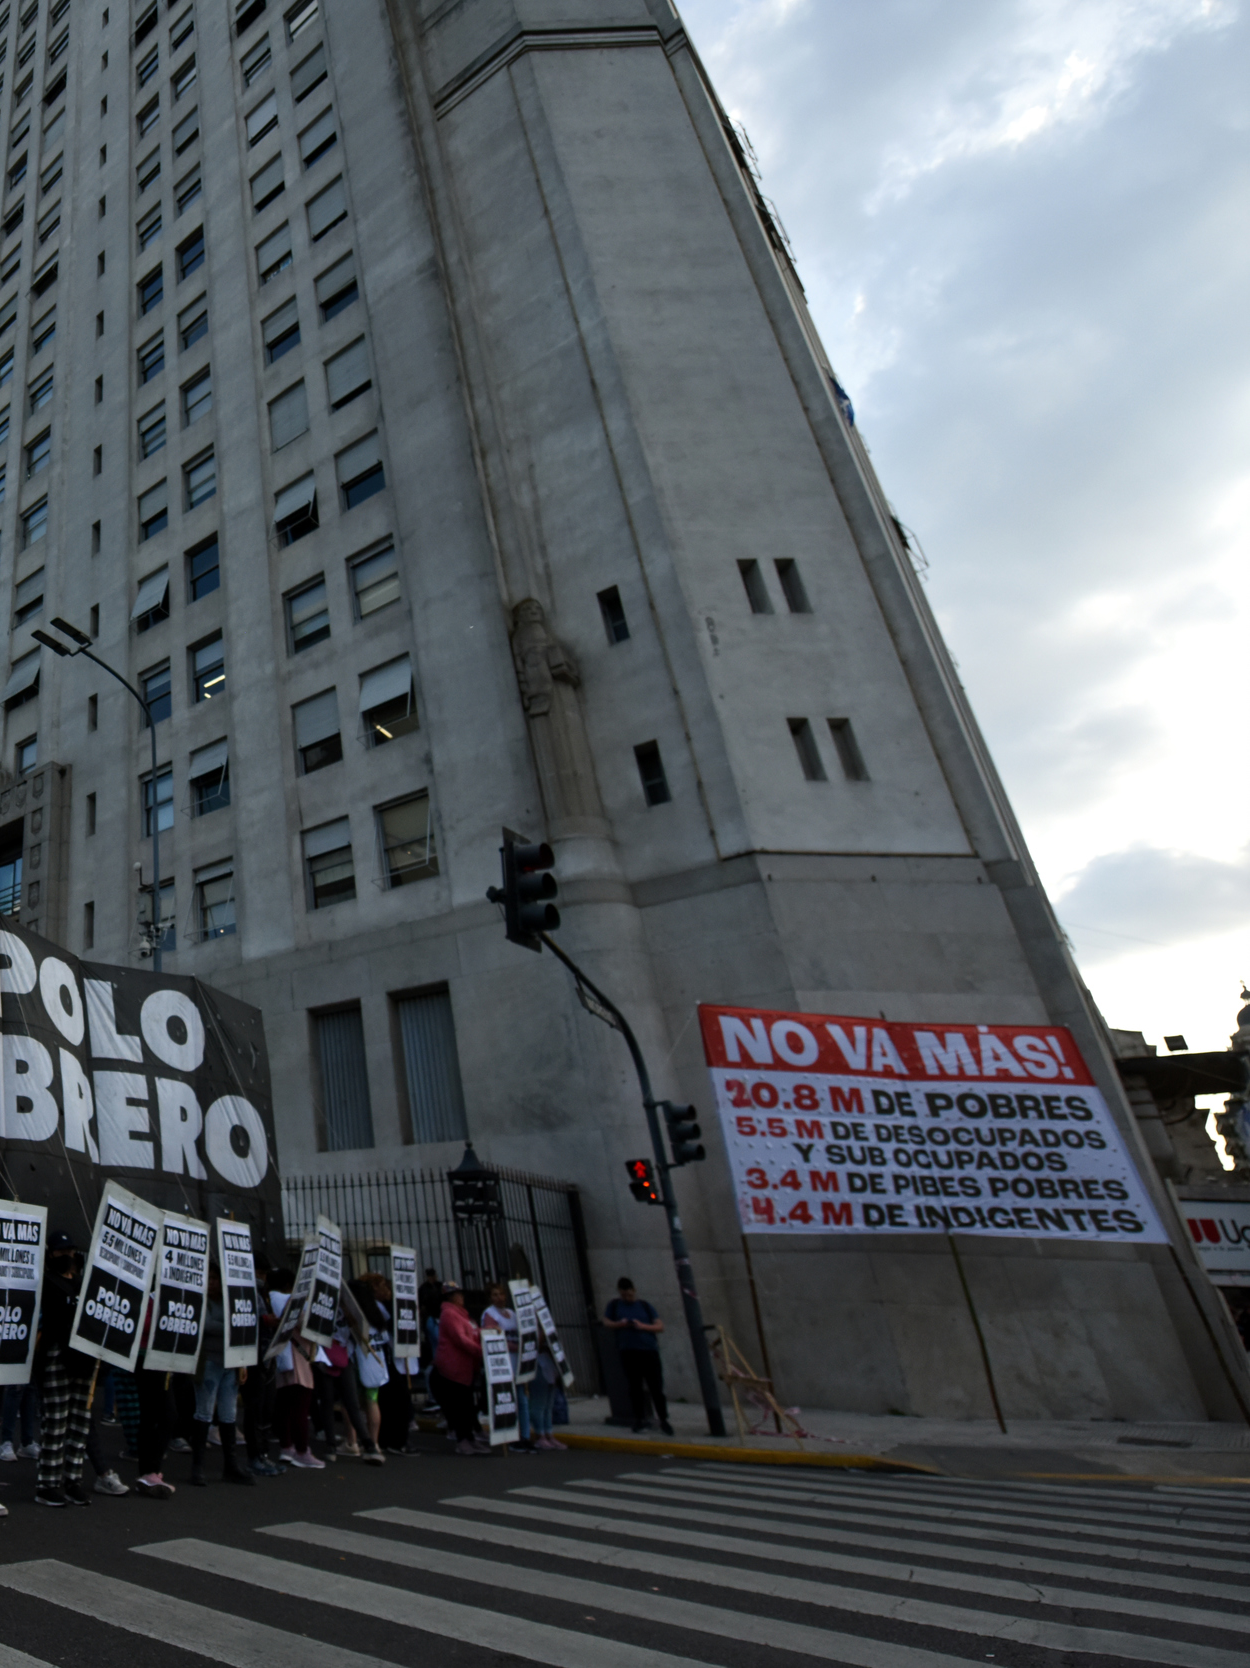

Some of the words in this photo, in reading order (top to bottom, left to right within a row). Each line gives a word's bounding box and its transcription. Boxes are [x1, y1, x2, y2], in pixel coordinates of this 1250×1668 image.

[718, 1015, 820, 1067] NO
[825, 1022, 910, 1075] VA
[725, 1079, 821, 1110] 20.8
[828, 1086, 865, 1114] M
[871, 1089, 917, 1117] DE
[924, 1092, 1094, 1122] POBRES
[735, 1116, 788, 1138] 5.5
[795, 1119, 825, 1140] M
[830, 1121, 869, 1142] DE
[874, 1124, 1107, 1150] DESOCUPADOS
[792, 1143, 816, 1163] Y
[825, 1144, 887, 1167] SUB
[893, 1147, 1068, 1173] OCUPADOS
[746, 1167, 801, 1191] 3.4
[809, 1170, 840, 1192] M
[846, 1172, 887, 1194] DE
[892, 1174, 982, 1198] PIBES
[988, 1177, 1129, 1201] POBRES
[752, 1196, 813, 1225] 4.4
[821, 1201, 853, 1226] M
[863, 1203, 909, 1227] DE
[915, 1204, 1144, 1233] INDIGENTES
[2, 1222, 16, 1240] VA
[17, 1224, 39, 1242] MÁS
[102, 1231, 115, 1248] 5.5
[107, 1208, 121, 1229] NO
[121, 1216, 133, 1237] VA
[133, 1223, 155, 1247] MÁS
[166, 1228, 178, 1247] NO
[180, 1231, 190, 1249] VA
[191, 1232, 207, 1252] MÁS
[0, 1246, 30, 1265] MILLONES
[165, 1250, 173, 1264] 4
[177, 1252, 204, 1271] MILLONES
[168, 1267, 203, 1287] INDIGENTES
[96, 1286, 131, 1315] POLO
[168, 1301, 194, 1319] POLO
[234, 1299, 253, 1312] POLO
[85, 1300, 134, 1334] OBRERO
[159, 1315, 198, 1336] OBRERO
[232, 1313, 257, 1327] OBRERO
